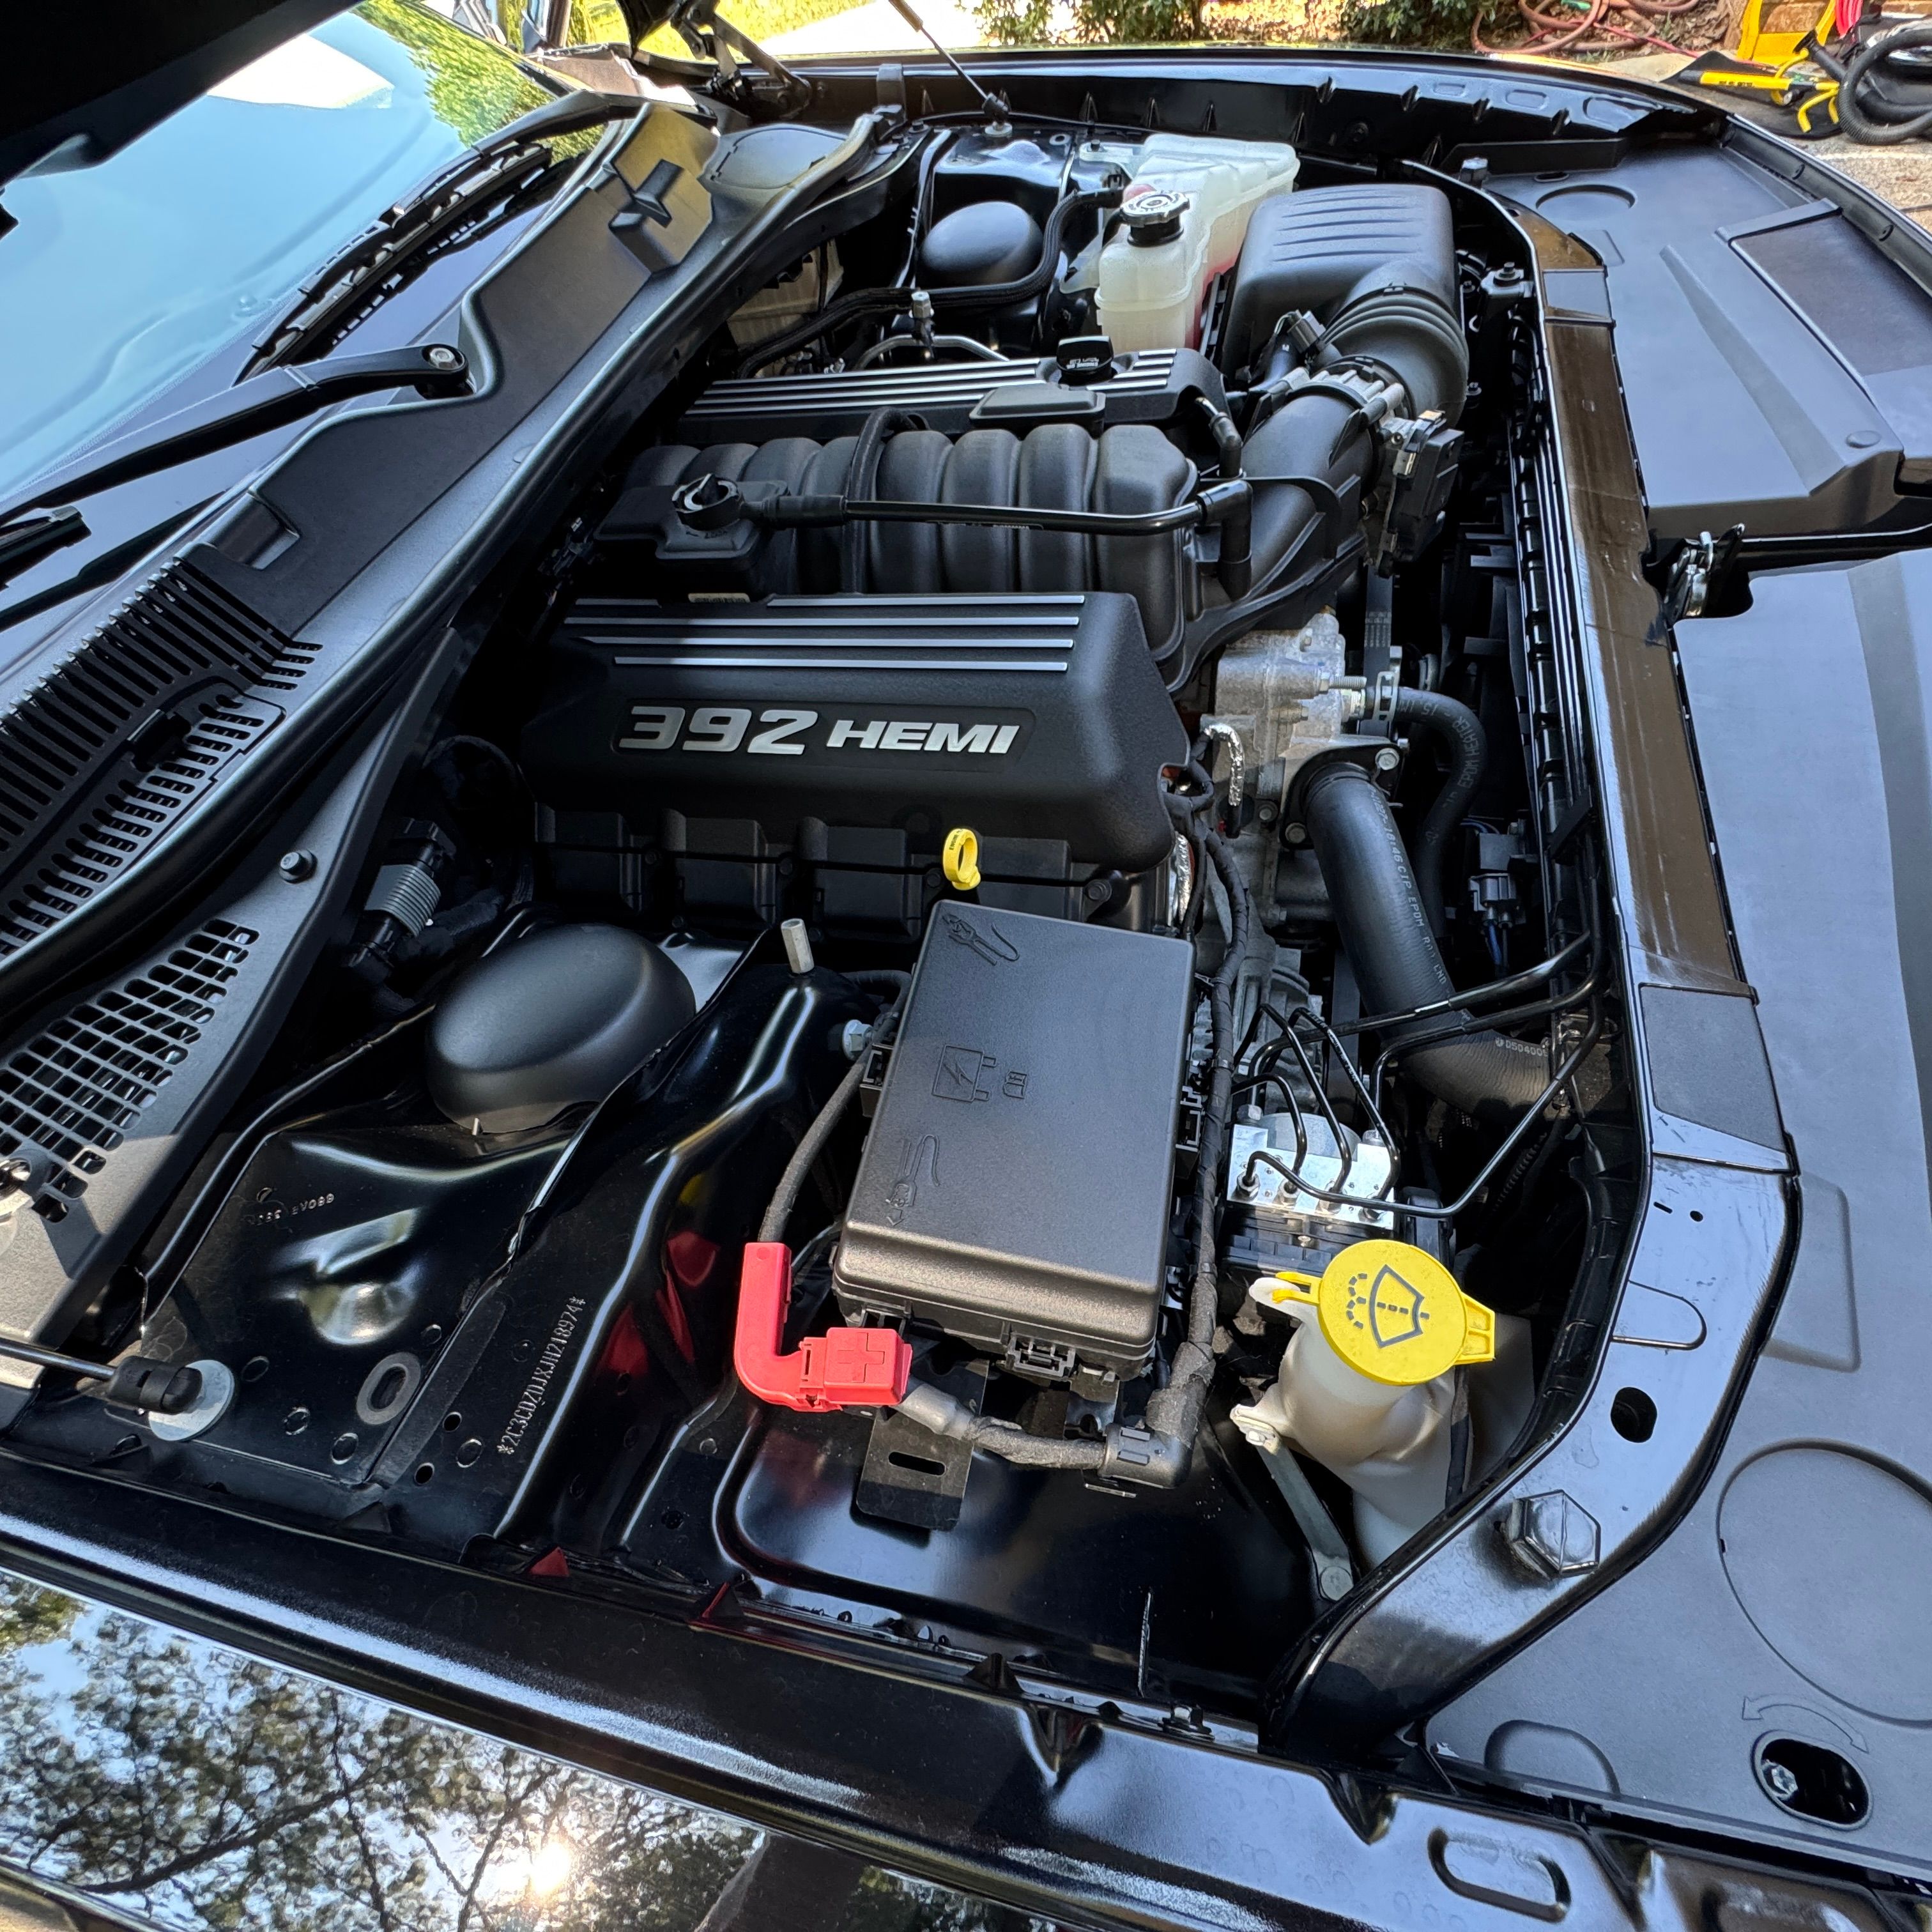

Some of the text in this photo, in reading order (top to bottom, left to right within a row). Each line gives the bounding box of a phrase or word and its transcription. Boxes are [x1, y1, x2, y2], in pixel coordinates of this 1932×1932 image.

[618, 705, 1020, 755] 392 HEMI
[1452, 716, 1480, 756] HEATER
[1397, 865, 1412, 889] CIP
[1407, 896, 1425, 927] EPDM
